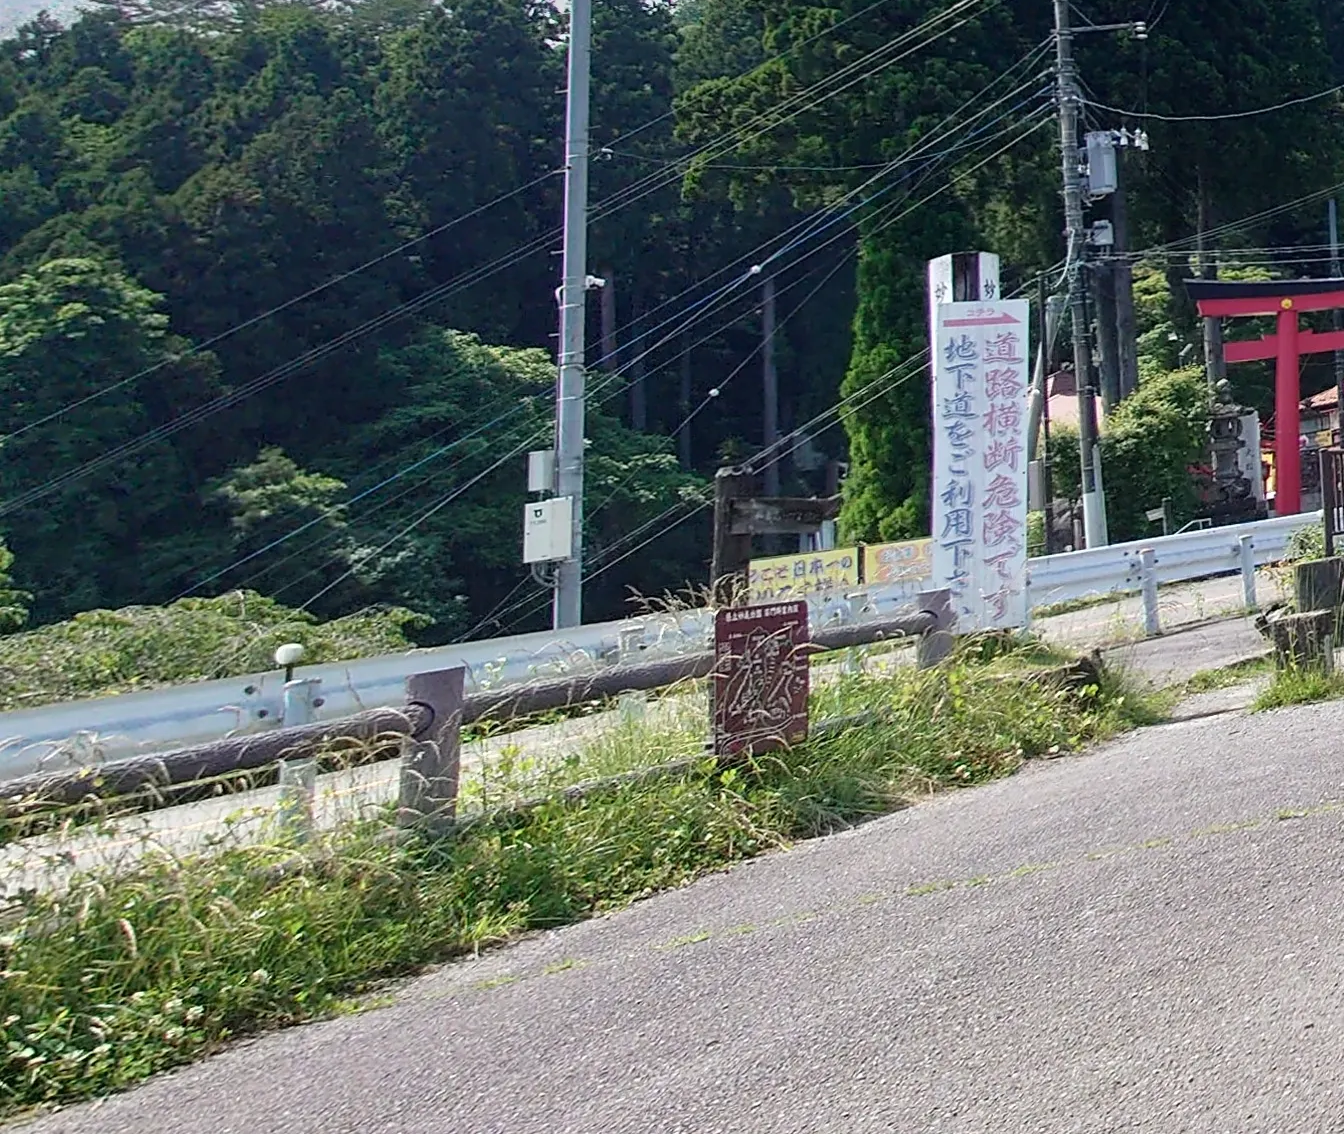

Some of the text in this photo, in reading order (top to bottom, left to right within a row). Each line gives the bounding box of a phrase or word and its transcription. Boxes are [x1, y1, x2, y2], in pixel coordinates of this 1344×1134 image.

[980, 331, 1024, 621] 道路横断危険です
